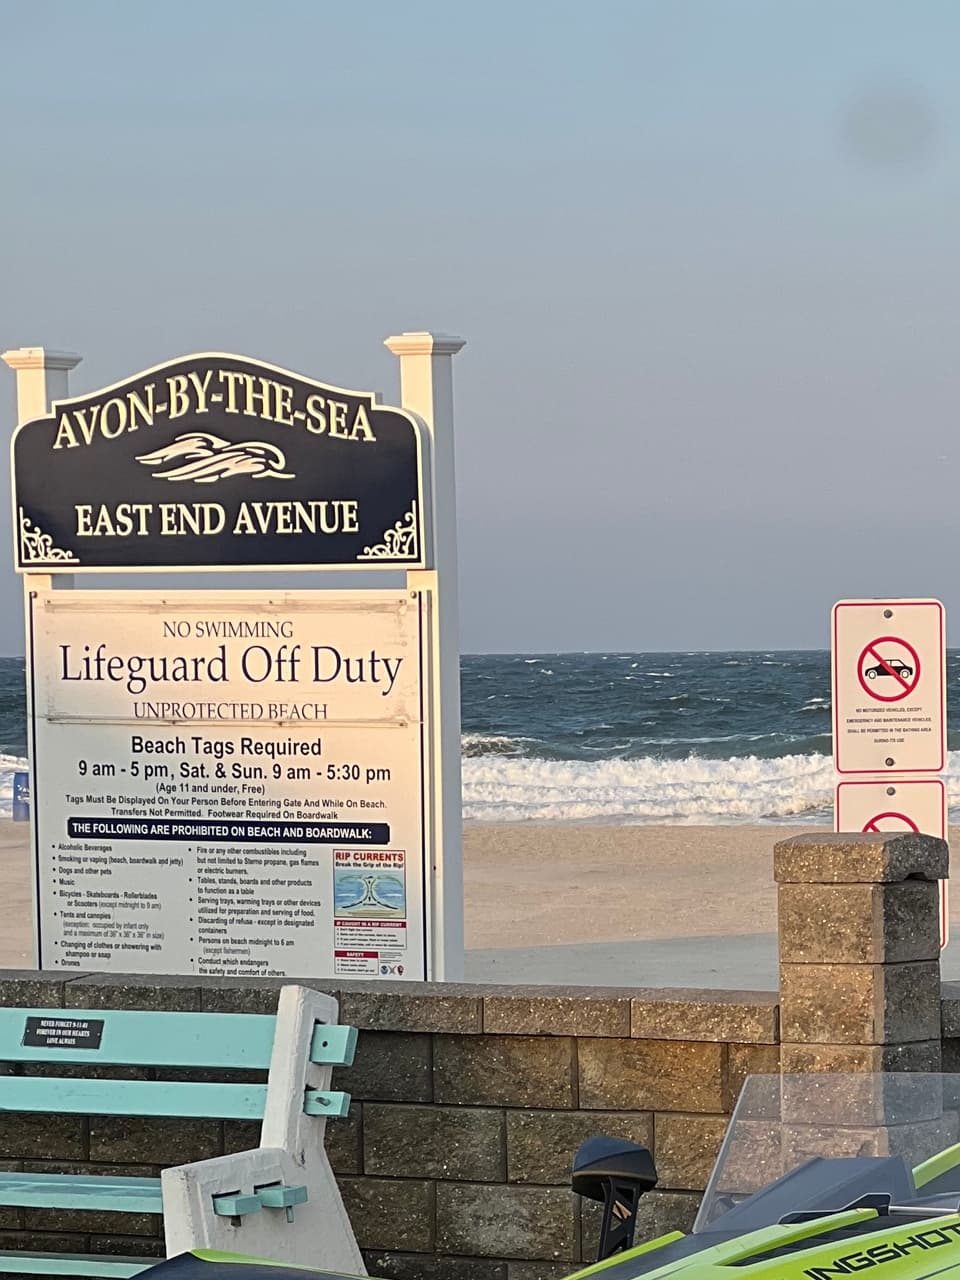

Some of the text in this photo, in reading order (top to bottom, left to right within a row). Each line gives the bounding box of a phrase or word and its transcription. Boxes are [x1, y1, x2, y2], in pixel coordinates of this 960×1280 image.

[53, 369, 377, 449] AVON-BY-THE-SEA
[76, 501, 358, 536] EAST END AVENUE
[162, 621, 294, 638] NO SWIMMING
[60, 644, 404, 696] Lifeguard Off Duty
[133, 702, 327, 720] UNPROTECTED BEACH
[132, 736, 322, 758] Beach Tags Required
[78, 760, 87, 776] 9
[92, 764, 115, 776] am
[131, 761, 139, 777] 5
[144, 764, 174, 780] pm,
[180, 762, 210, 778] Sat.
[216, 763, 226, 778] &
[232, 763, 267, 779] Sun.
[273, 764, 281, 779] 9
[287, 767, 311, 780] am
[327, 765, 359, 780] 5:30
[366, 768, 391, 784] pm
[156, 783, 265, 795] (Age 11 and under, Free)
[66, 795, 84, 804] Tags
[86, 795, 104, 803] Must
[119, 796, 156, 805] Displayed
[249, 799, 281, 808] Entering
[284, 799, 302, 807] Gate
[304, 800, 320, 808] And
[112, 808, 147, 816] Transfers
[150, 808, 163, 816] Not
[246, 810, 280, 820] Required
[297, 811, 338, 819] Boardwalk
[72, 823, 372, 838] THE FOLLOWING ARE PROHIBITED ON BEACH AND BOARDWALK:
